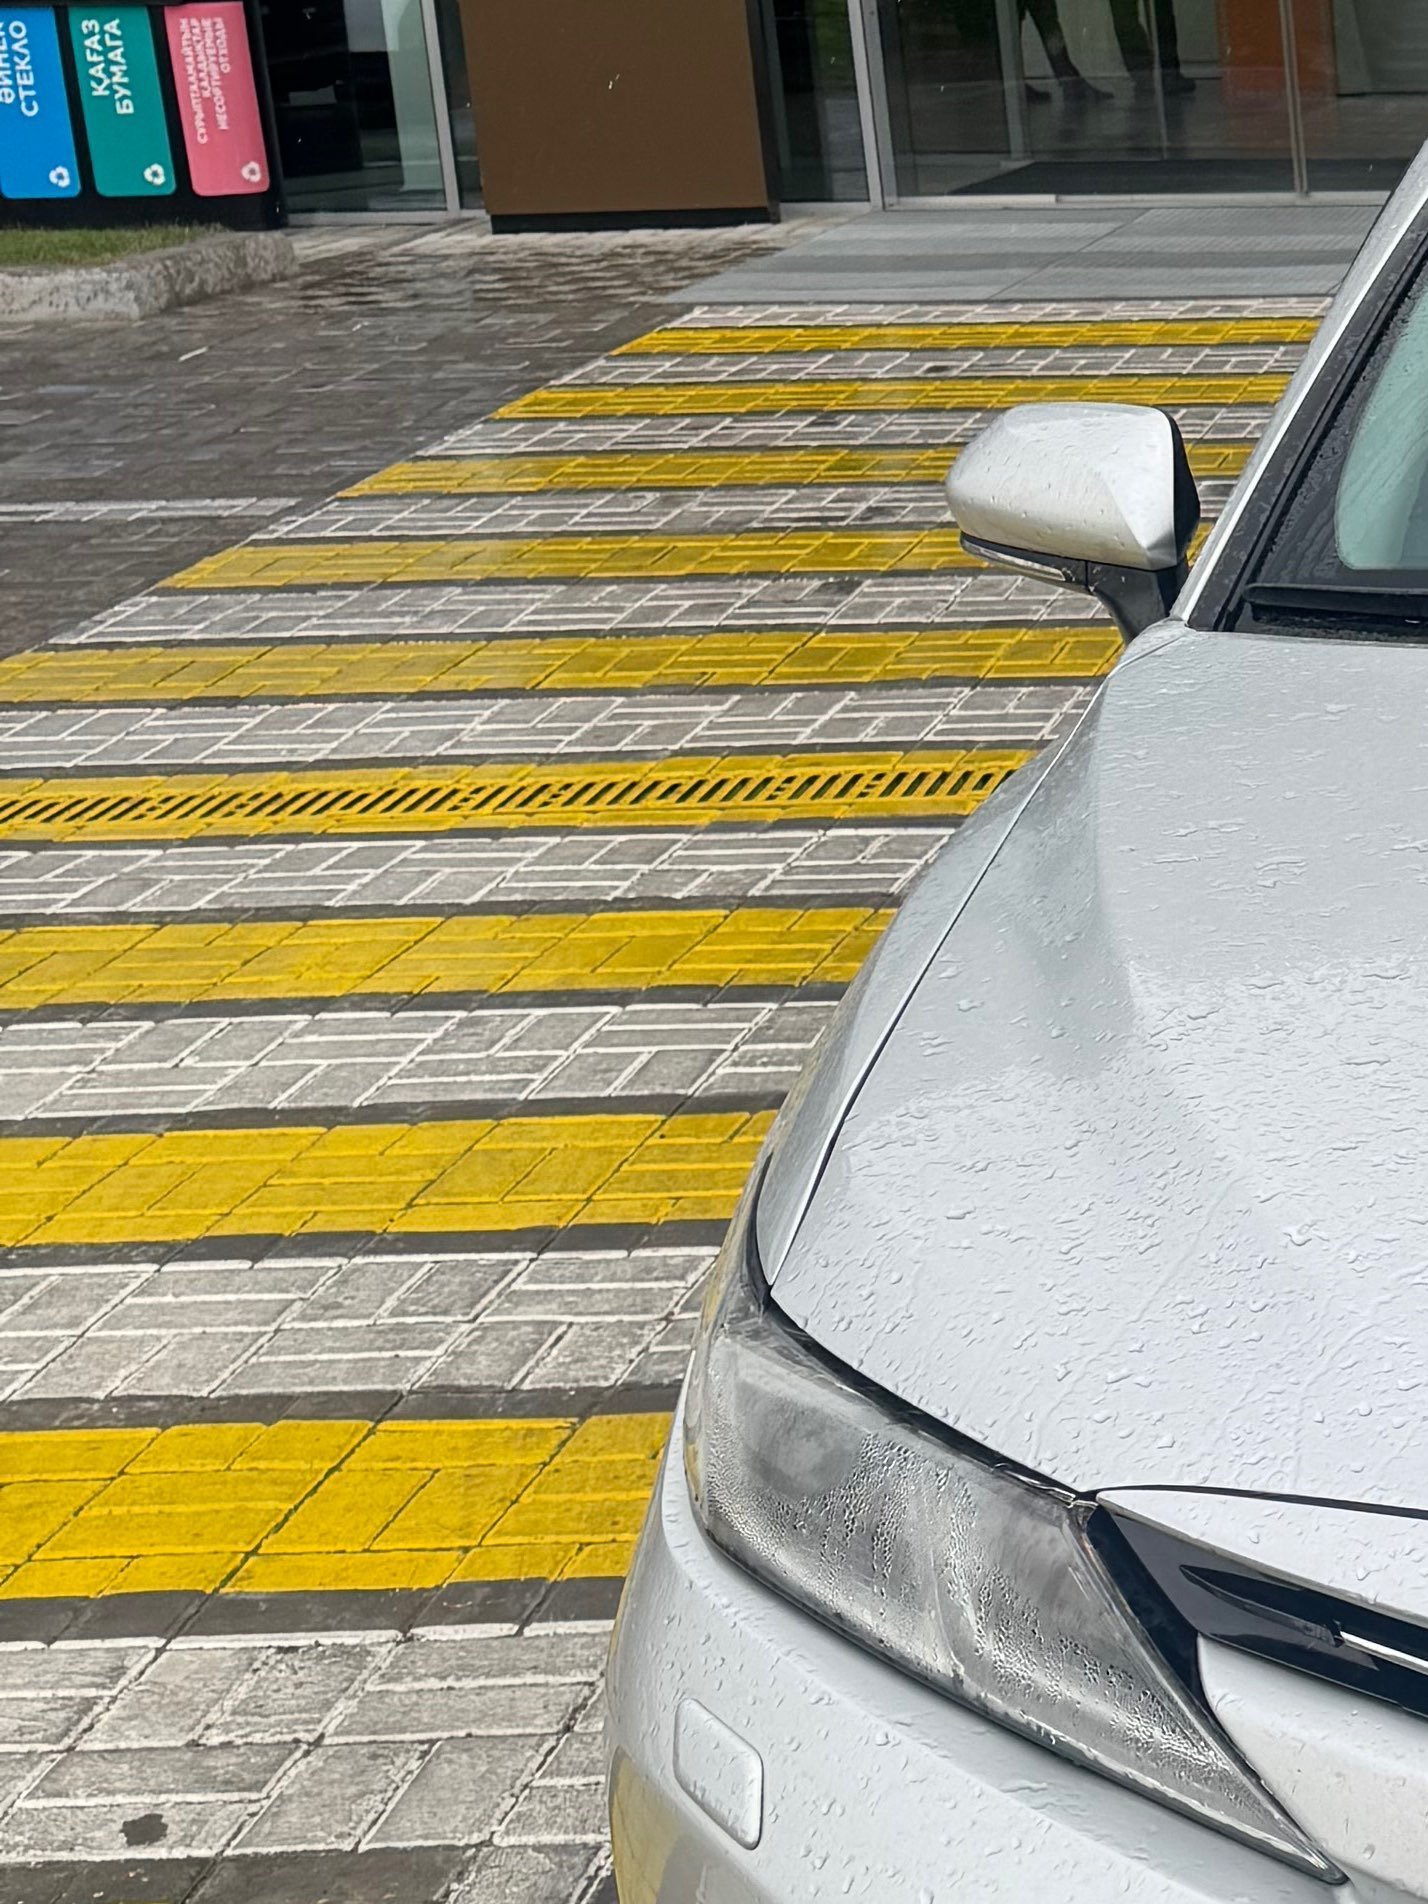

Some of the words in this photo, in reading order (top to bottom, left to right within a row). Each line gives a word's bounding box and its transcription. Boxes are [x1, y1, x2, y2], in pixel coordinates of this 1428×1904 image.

[8, 20, 40, 117] СТЕКЛО
[81, 19, 112, 96] ҚАҒАЗ
[104, 18, 135, 115] БУМАГА
